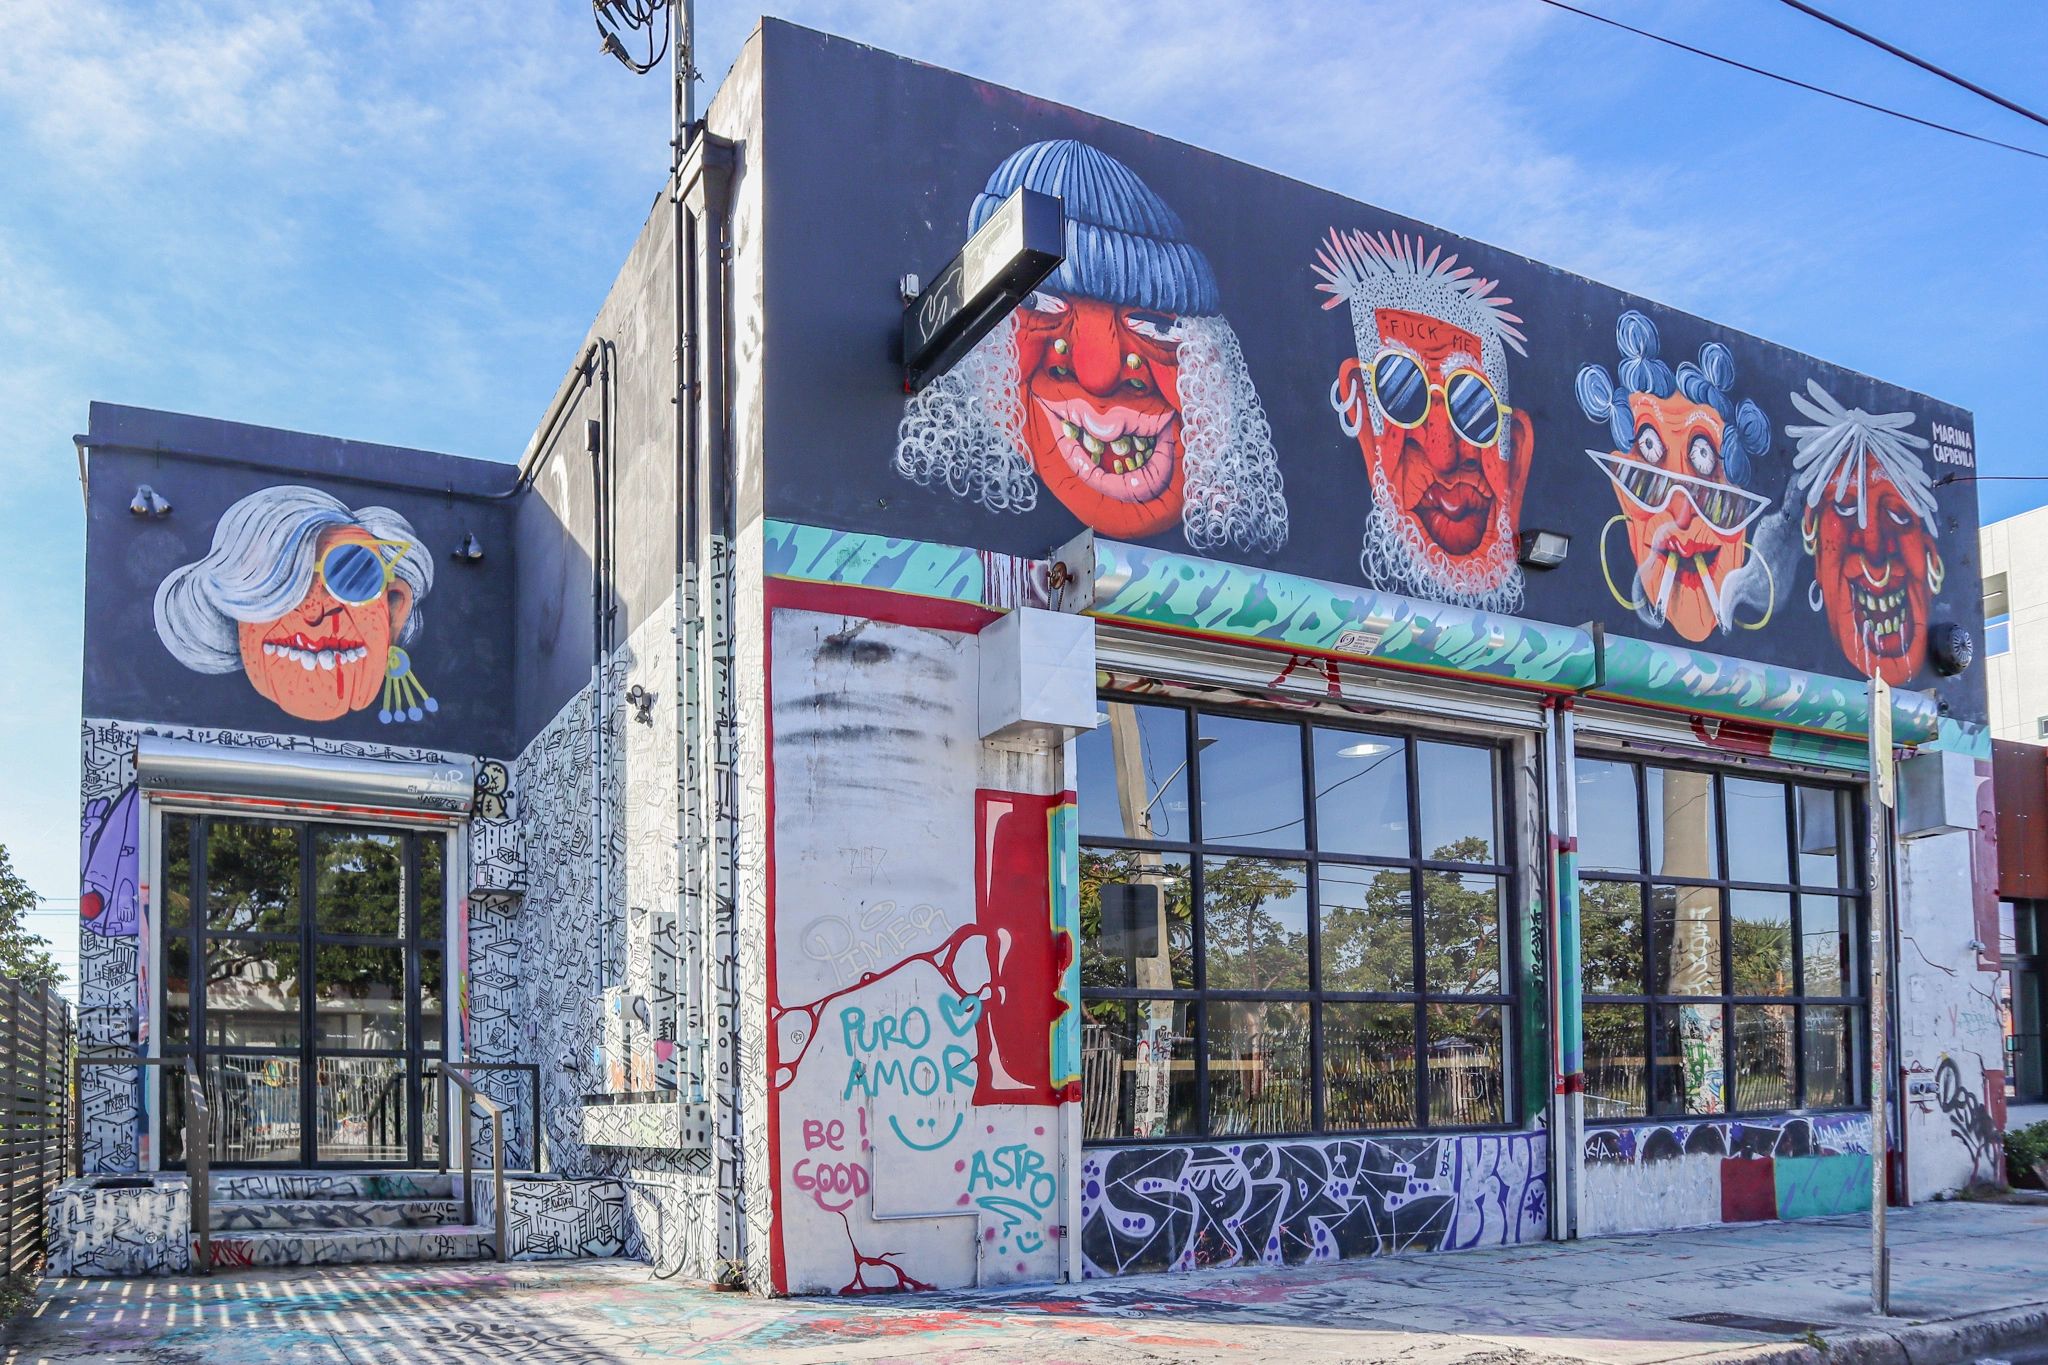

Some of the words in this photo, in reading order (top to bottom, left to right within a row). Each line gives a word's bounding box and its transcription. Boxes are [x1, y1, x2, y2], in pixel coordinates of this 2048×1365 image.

[1390, 320, 1438, 342] FUCK
[1453, 334, 1472, 353] ME
[1932, 421, 1973, 450] MARINA
[1933, 443, 1974, 469] CAPDEVILA
[840, 1006, 931, 1057] PURO
[843, 1045, 975, 1101] AMOR
[793, 1157, 870, 1198] GOOD
[967, 1143, 1056, 1209] ASTRO
